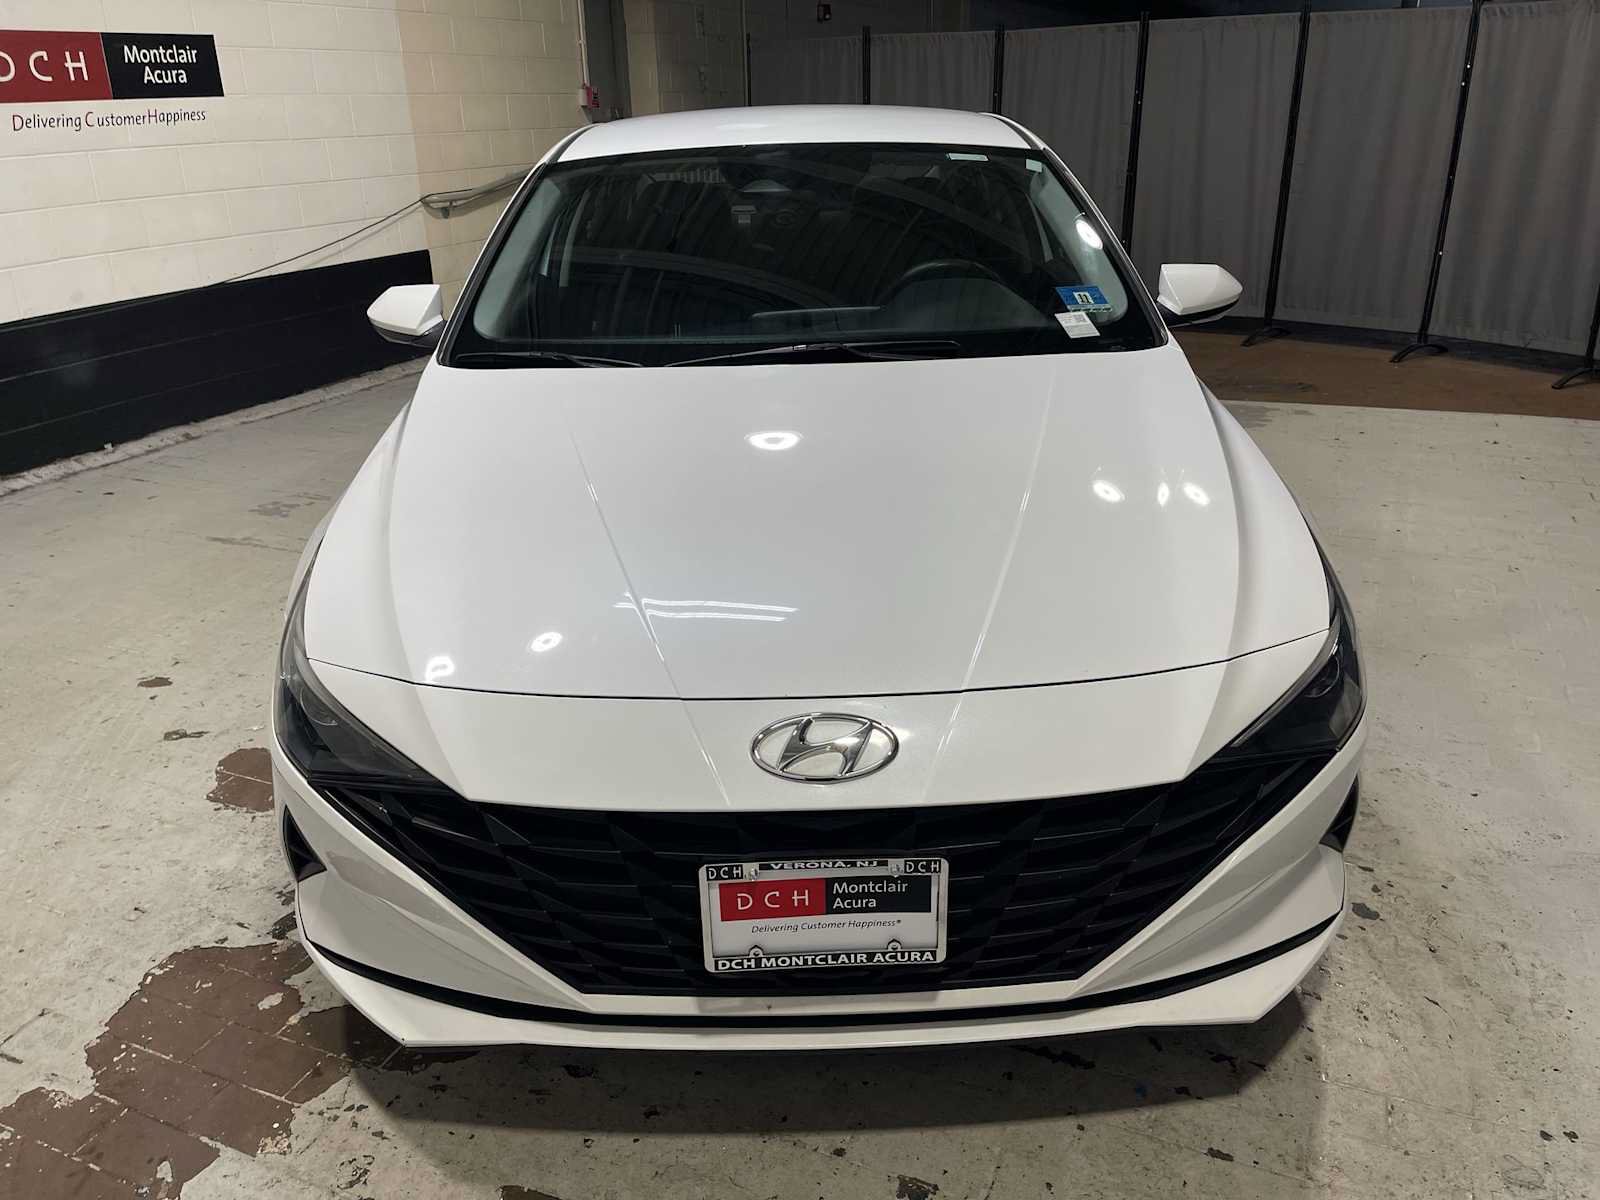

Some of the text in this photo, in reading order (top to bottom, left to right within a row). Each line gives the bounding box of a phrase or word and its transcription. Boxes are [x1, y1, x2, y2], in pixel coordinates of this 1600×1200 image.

[124, 45, 198, 63] Montclair
[144, 66, 187, 84] Acura
[12, 109, 206, 131] Delivering Customer Happiness
[708, 867, 742, 880] DCH
[906, 861, 940, 873] DCH
[833, 880, 908, 894] Montclair
[737, 890, 809, 910] DCH
[833, 898, 877, 909] Acura
[751, 924, 799, 933] Delivering
[801, 921, 846, 931] Customer
[718, 951, 934, 970] DCH MONTCLAIR ACURA
